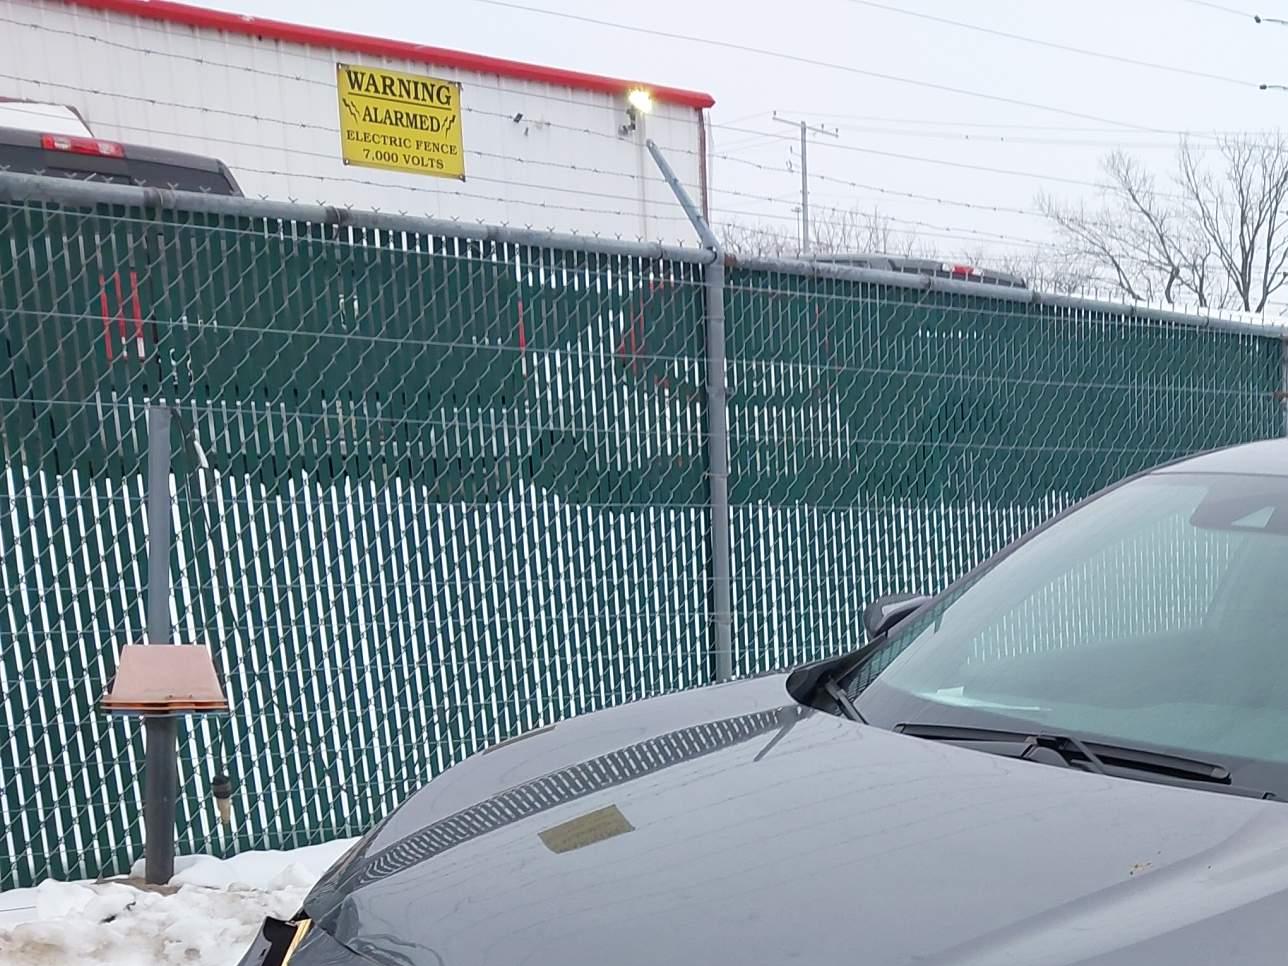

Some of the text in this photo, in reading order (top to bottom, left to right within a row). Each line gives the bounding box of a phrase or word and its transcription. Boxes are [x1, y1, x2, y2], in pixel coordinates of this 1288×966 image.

[345, 69, 452, 106] WARNING
[362, 105, 441, 133] ALARMED
[346, 129, 458, 156] ELECTRIC FENCE
[403, 153, 444, 170] VOLTS
